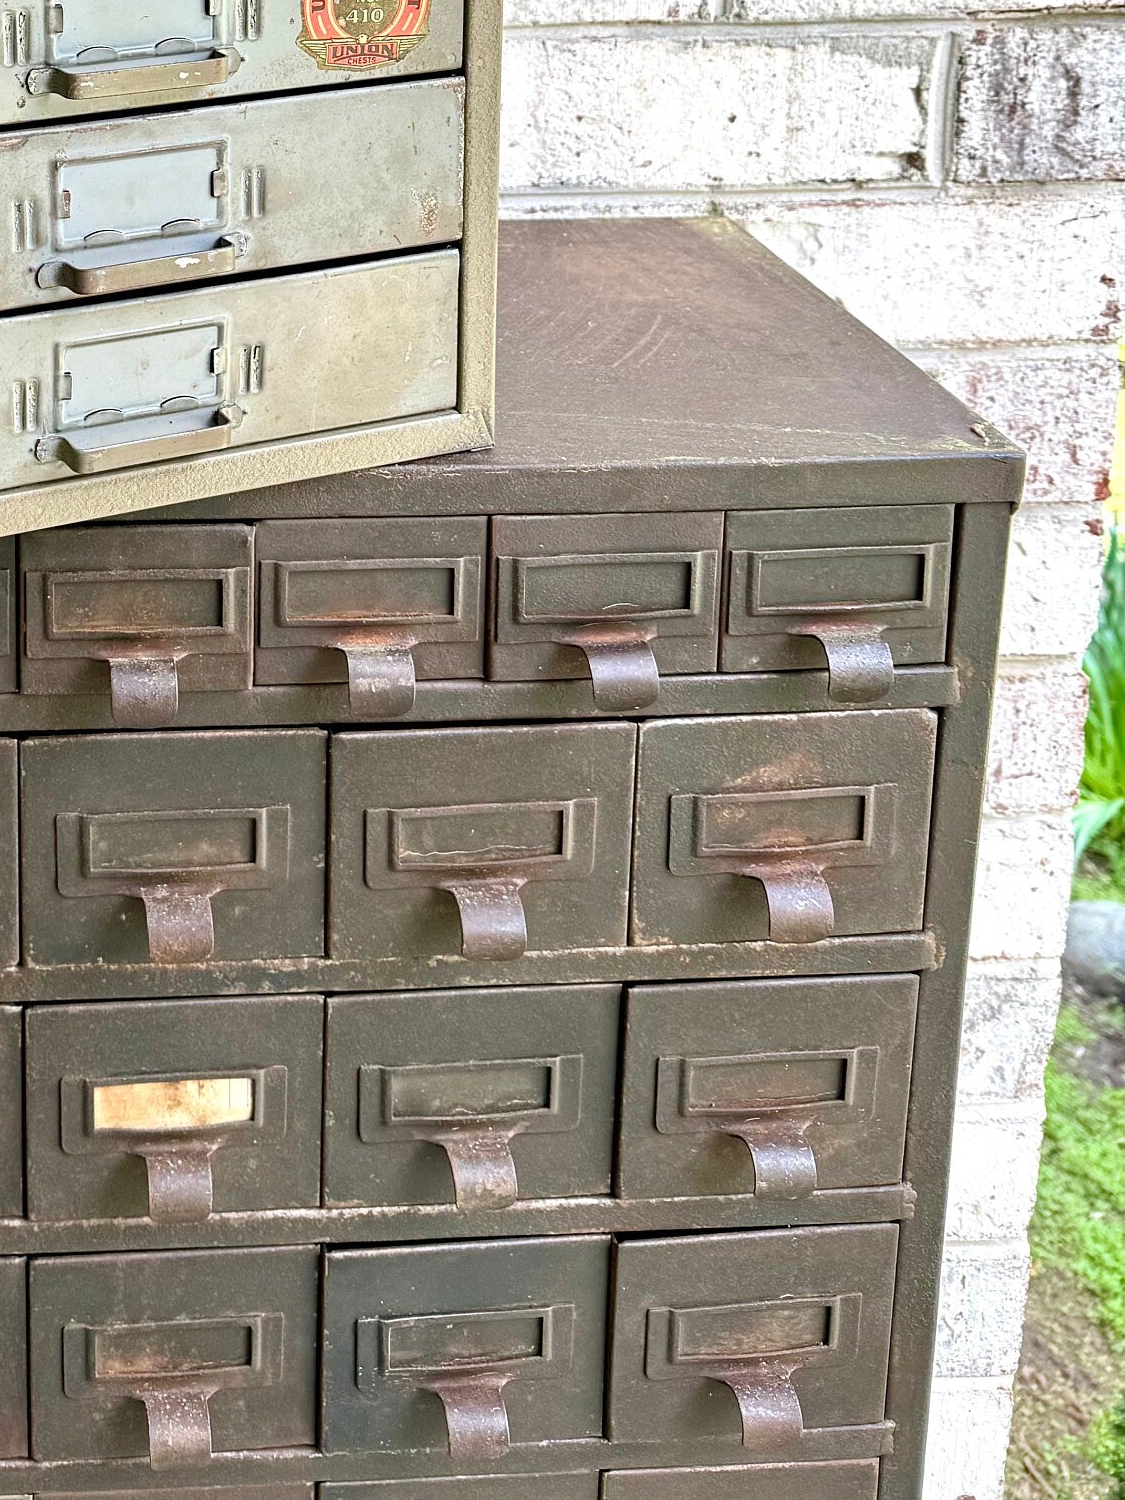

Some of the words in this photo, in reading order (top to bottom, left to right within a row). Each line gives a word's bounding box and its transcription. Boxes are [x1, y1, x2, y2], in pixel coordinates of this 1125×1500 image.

[345, 8, 384, 23] 410
[331, 43, 395, 59] UNION
[347, 56, 377, 65] CHESTS
